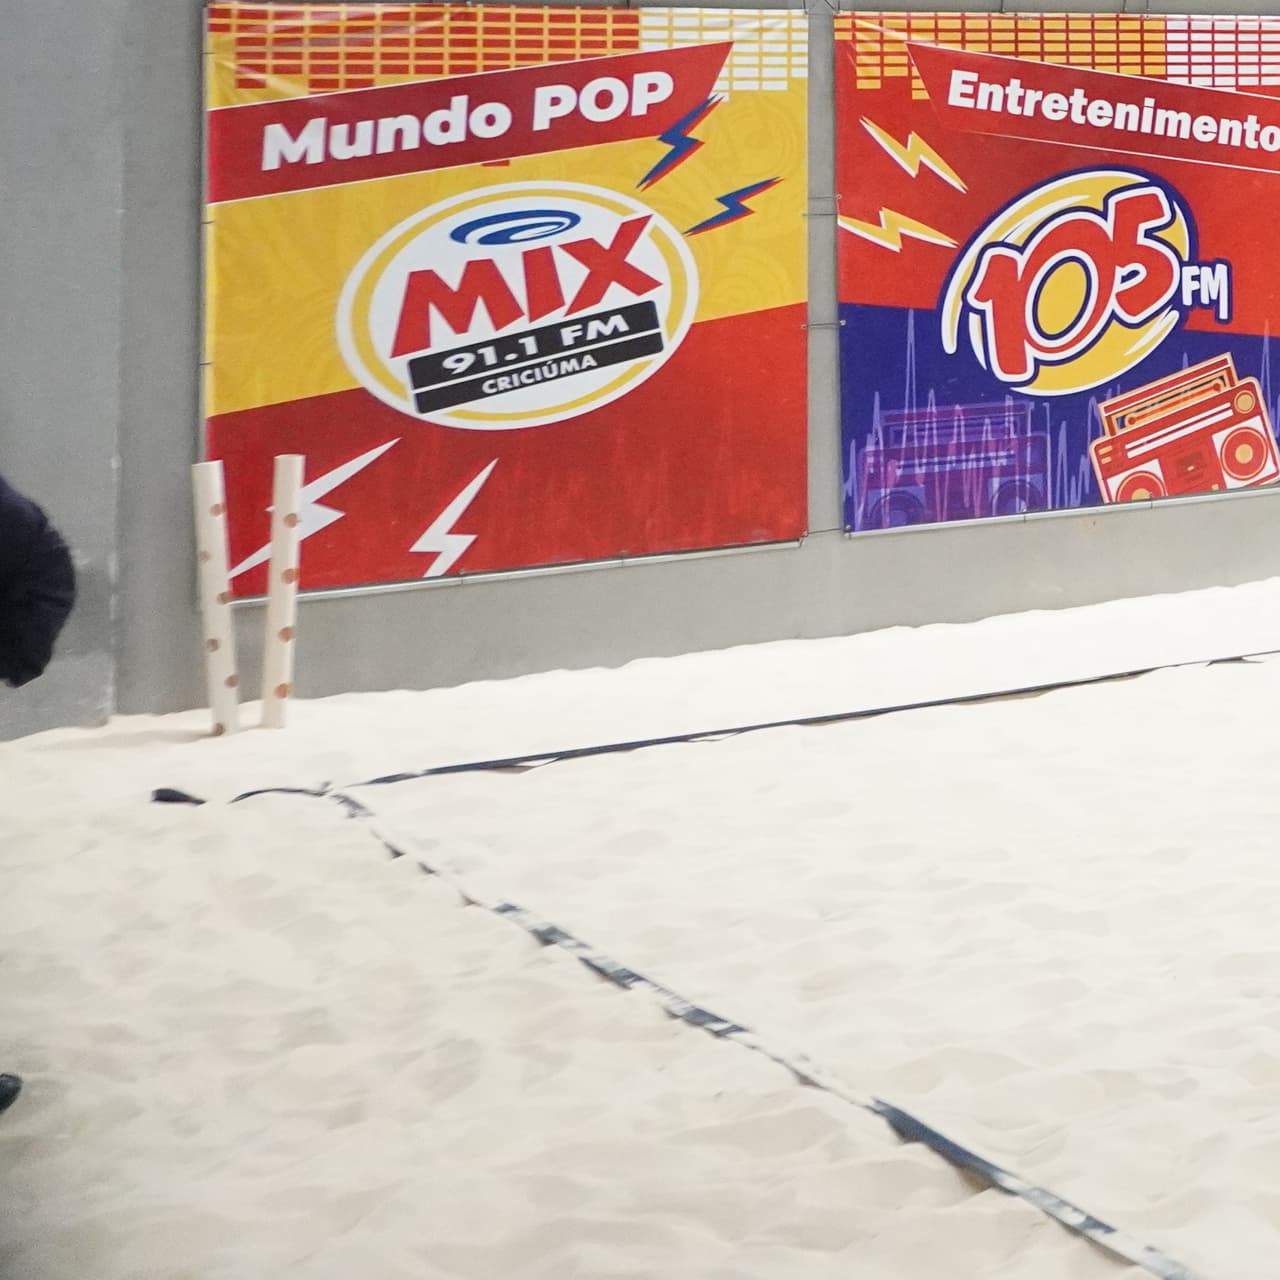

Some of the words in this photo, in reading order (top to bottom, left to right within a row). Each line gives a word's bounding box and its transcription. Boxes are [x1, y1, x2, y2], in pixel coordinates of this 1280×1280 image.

[261, 95, 512, 171] Mundo
[532, 70, 675, 131] POP
[390, 214, 664, 359] MIX
[968, 187, 1181, 382] 105
[1182, 263, 1230, 320] FM
[442, 335, 540, 375] 91.1
[561, 314, 631, 348] FM
[482, 353, 599, 395] CRICIÚMA
